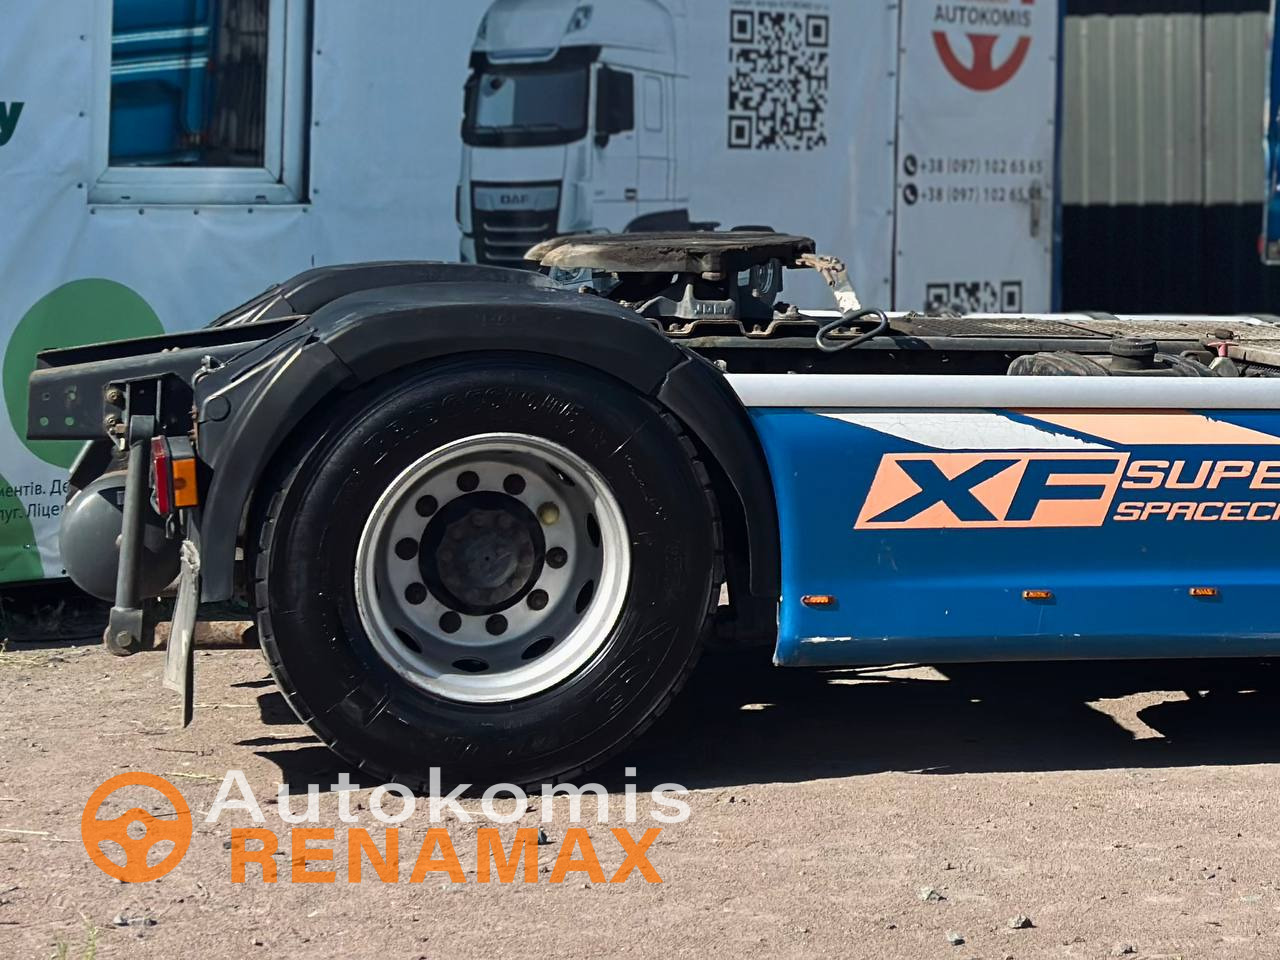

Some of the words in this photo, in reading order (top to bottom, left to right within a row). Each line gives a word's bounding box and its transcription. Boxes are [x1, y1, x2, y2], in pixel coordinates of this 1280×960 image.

[934, 5, 1032, 28] AUTOKOMIS
[500, 194, 530, 205] DAF
[867, 459, 1122, 522] XF
[26, 503, 64, 518] Ліце
